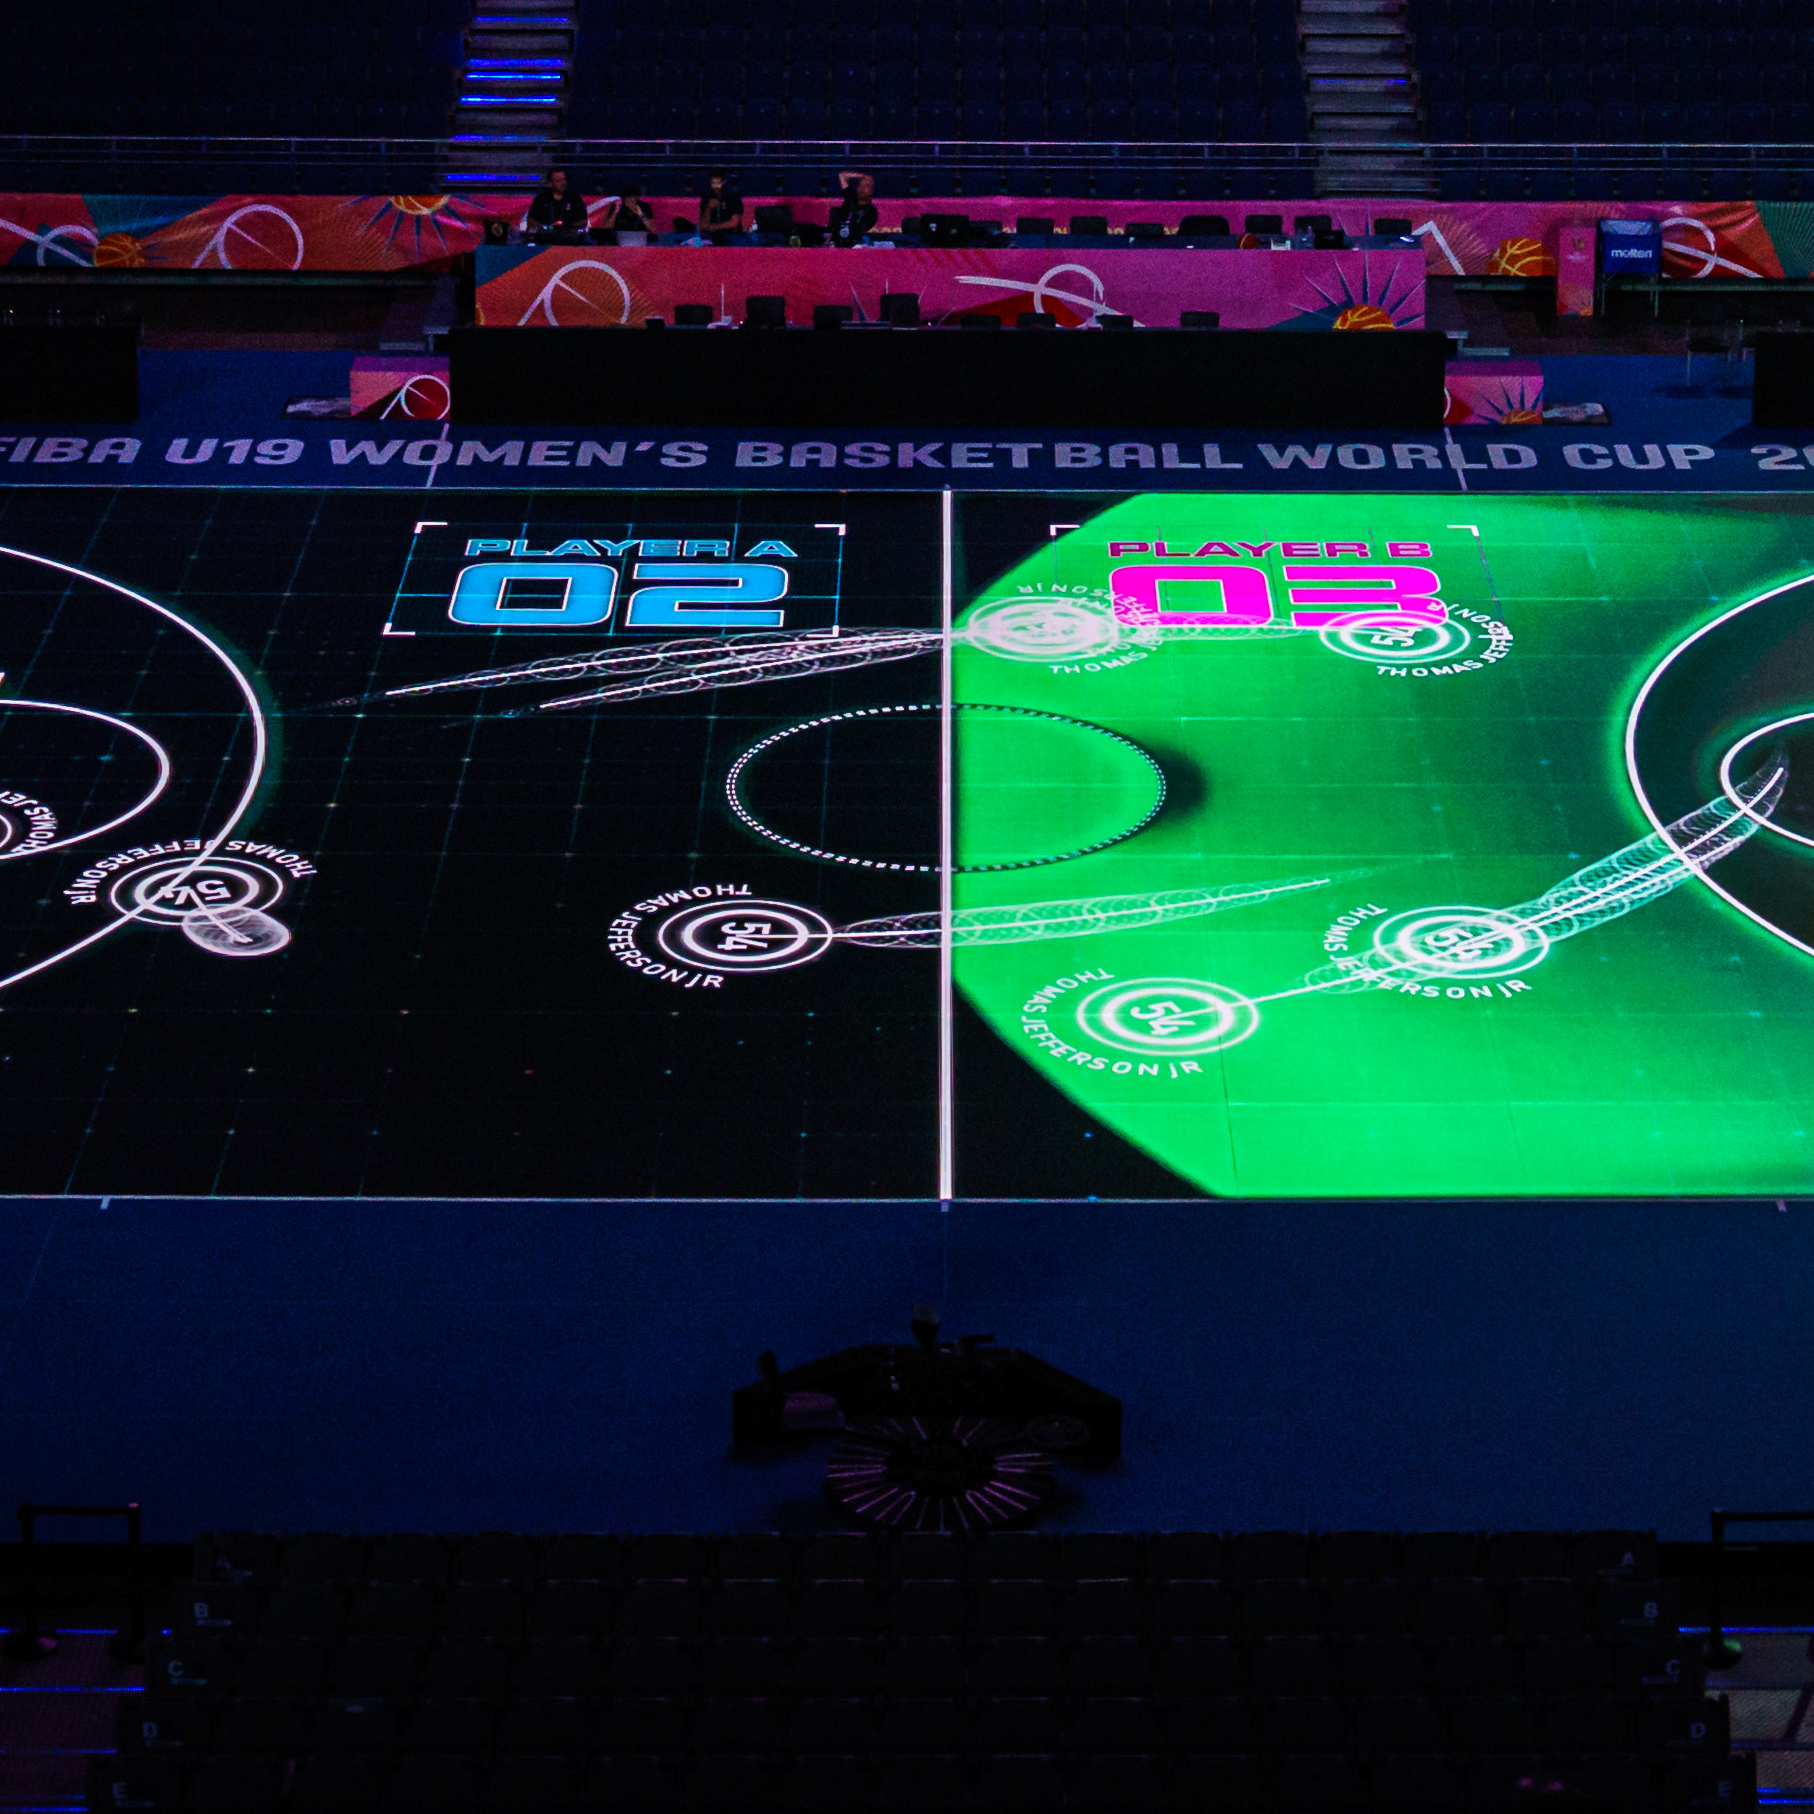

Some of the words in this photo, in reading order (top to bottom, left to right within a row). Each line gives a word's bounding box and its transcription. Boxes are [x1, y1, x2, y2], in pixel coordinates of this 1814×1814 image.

[1611, 248, 1652, 258] molten
[165, 438, 303, 467] U19
[329, 438, 709, 469] WOMEN'S
[735, 440, 1243, 470] BASKETBALL
[1258, 442, 1538, 471] WORLD
[1563, 443, 1716, 471] CUP
[464, 537, 736, 559] PLAYER
[743, 537, 799, 559] A
[1108, 540, 1370, 559] PLAYER
[1385, 541, 1433, 559] B
[448, 561, 788, 628] 02
[1109, 563, 1450, 628] 03
[1376, 660, 1484, 678] THOMAS
[225, 840, 318, 878] THOMAS
[635, 884, 752, 914] THOMAS
[717, 921, 771, 951] 54
[1323, 903, 1388, 952] THOMAS
[607, 911, 687, 983] JEFFERSON
[685, 973, 724, 988] JR
[1023, 967, 1114, 1015] THOMAS
[1130, 1001, 1196, 1035] 54
[1022, 1015, 1158, 1076] JEFFERSON
[1171, 1061, 1203, 1078] JR
